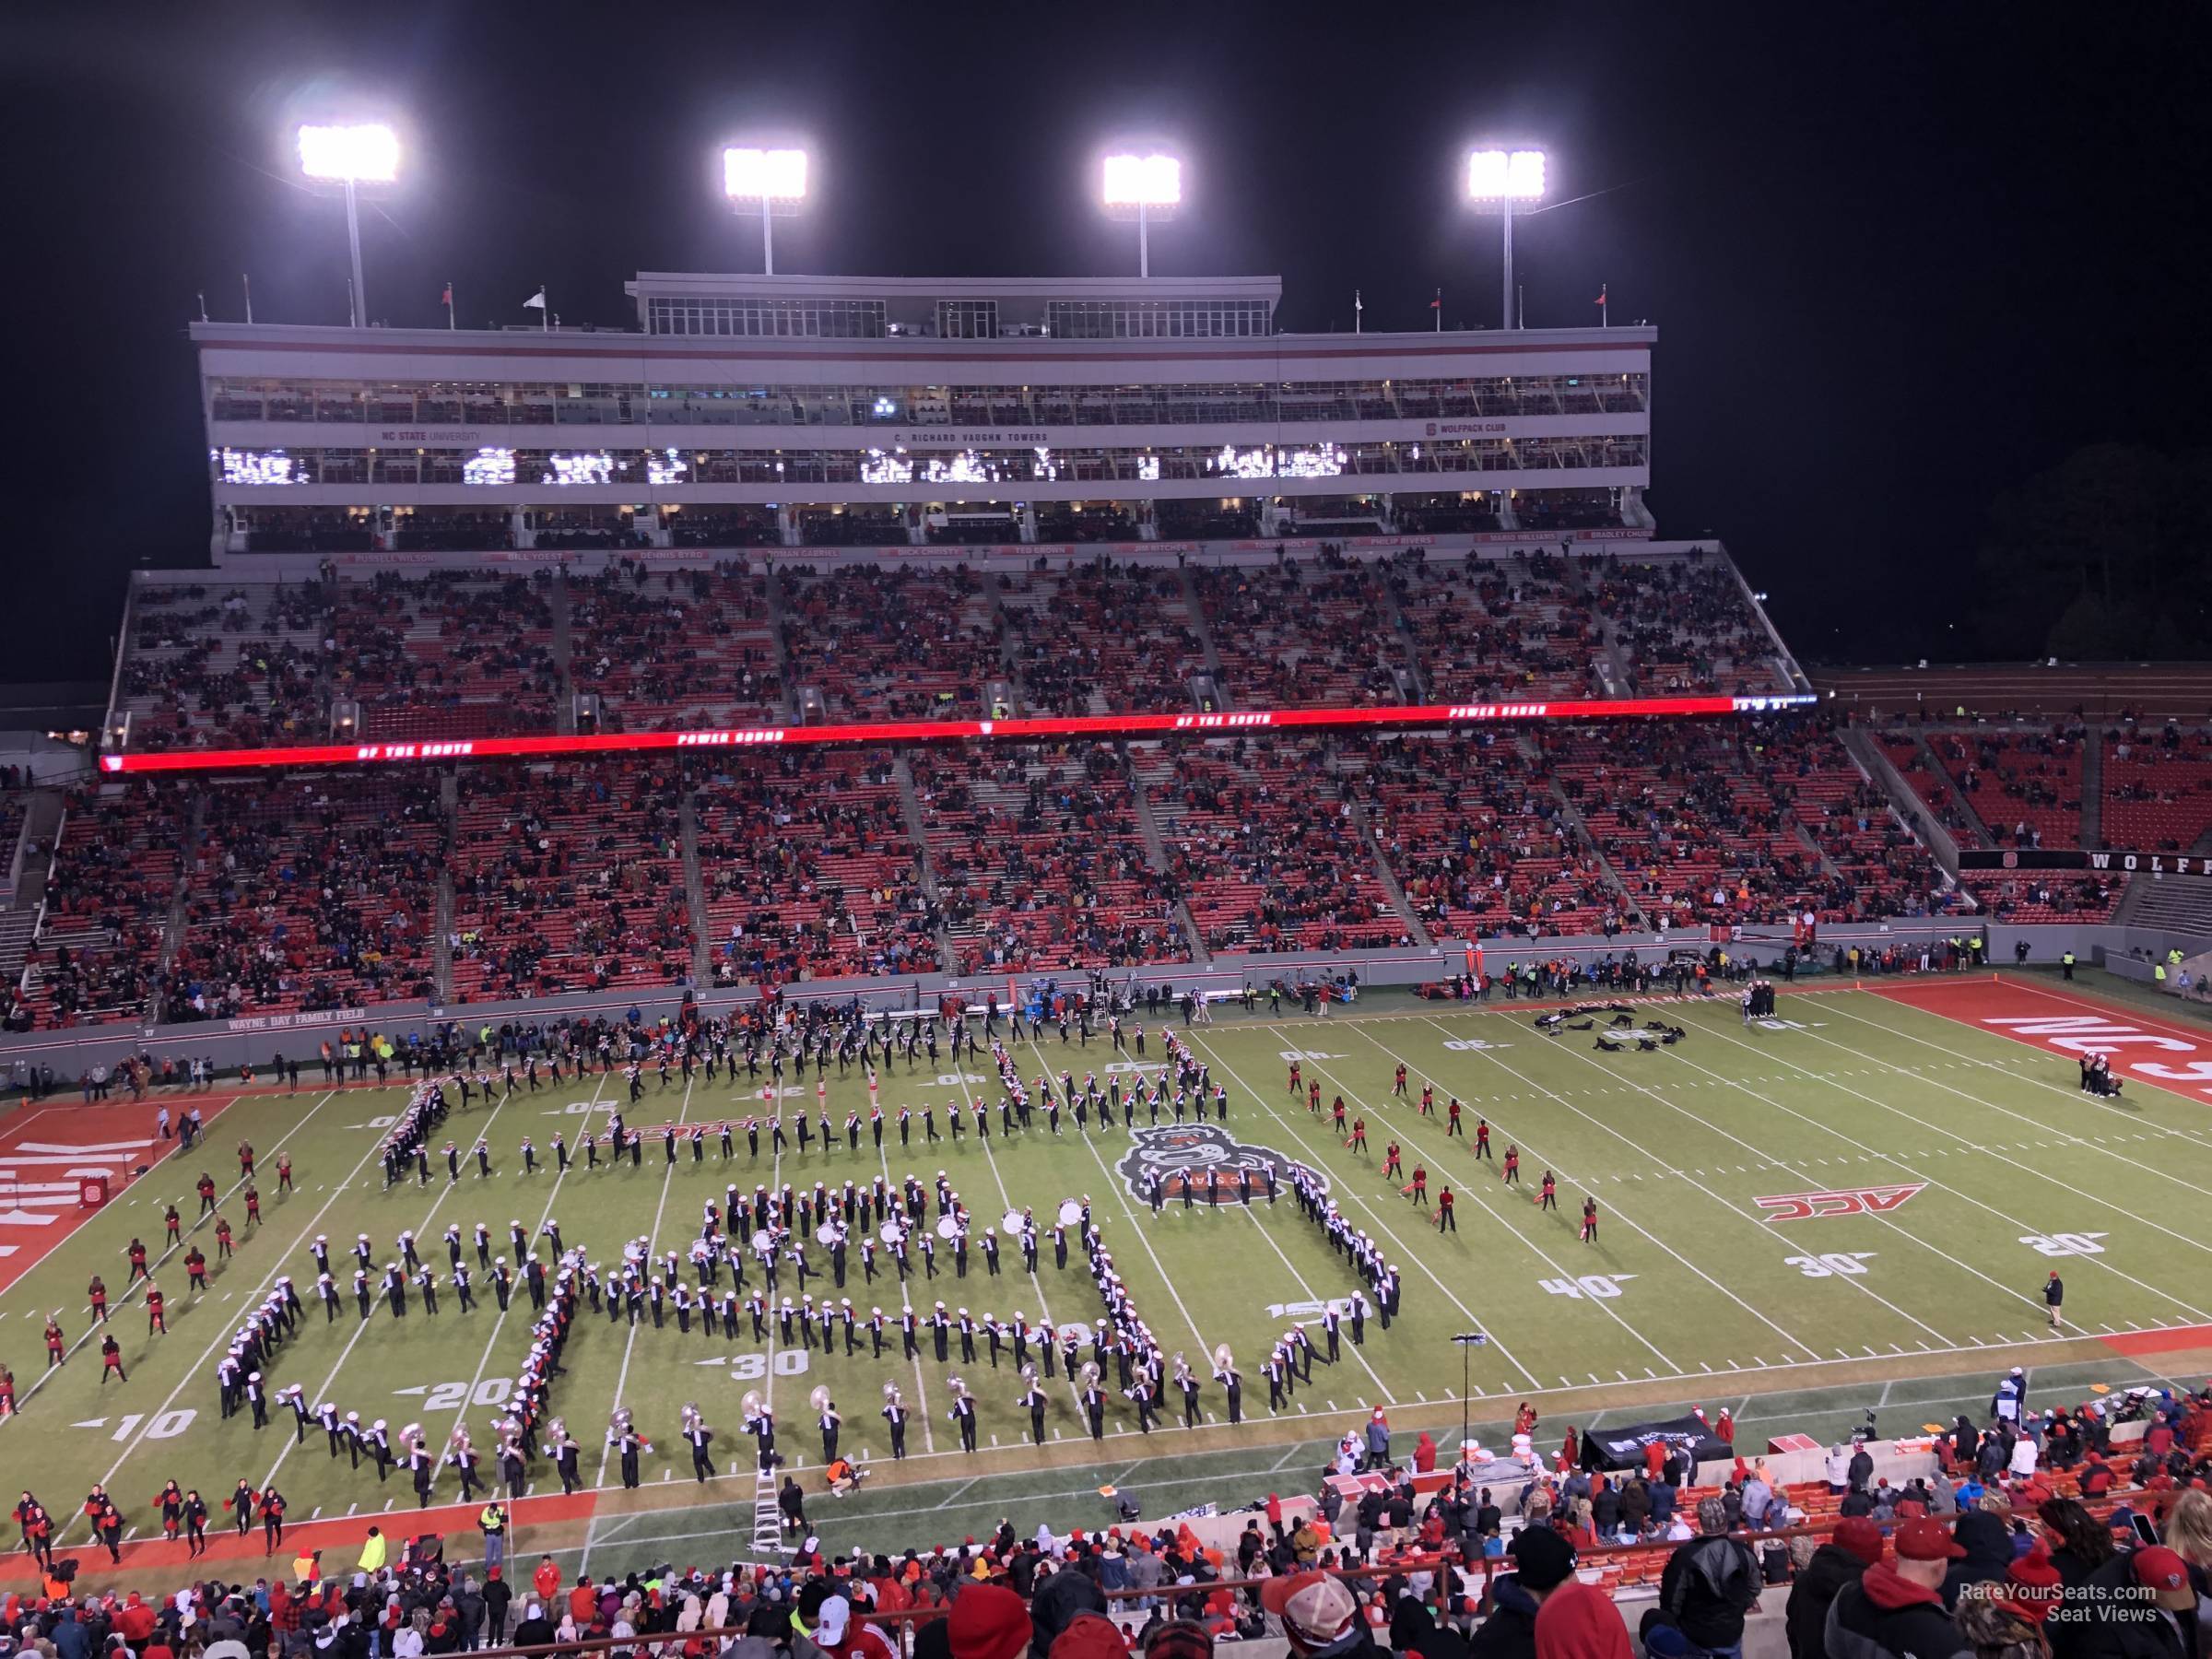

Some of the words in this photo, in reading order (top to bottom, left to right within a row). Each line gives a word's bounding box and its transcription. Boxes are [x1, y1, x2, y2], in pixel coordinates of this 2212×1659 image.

[382, 431, 395, 441] NC
[398, 431, 427, 441] STATE
[429, 431, 480, 441] UNIVERSITY
[1008, 433, 1048, 441] TOWERS
[1441, 424, 1483, 433] WOLFPACK
[1486, 423, 1506, 431] CLUB
[677, 733, 729, 746] POWER
[228, 1018, 266, 1030] WAYNE
[270, 1015, 293, 1027] DAY
[295, 1011, 334, 1024] FAMILY
[335, 1008, 365, 1020] FIELD
[1981, 1016, 2197, 1053] NC
[563, 1100, 619, 1114] 20
[2018, 1233, 2106, 1257] 20
[1783, 1253, 1868, 1277] 30
[1537, 1276, 1623, 1300] 40
[730, 1349, 809, 1381] 30
[423, 1377, 513, 1412] 20
[111, 1408, 197, 1442] 10
